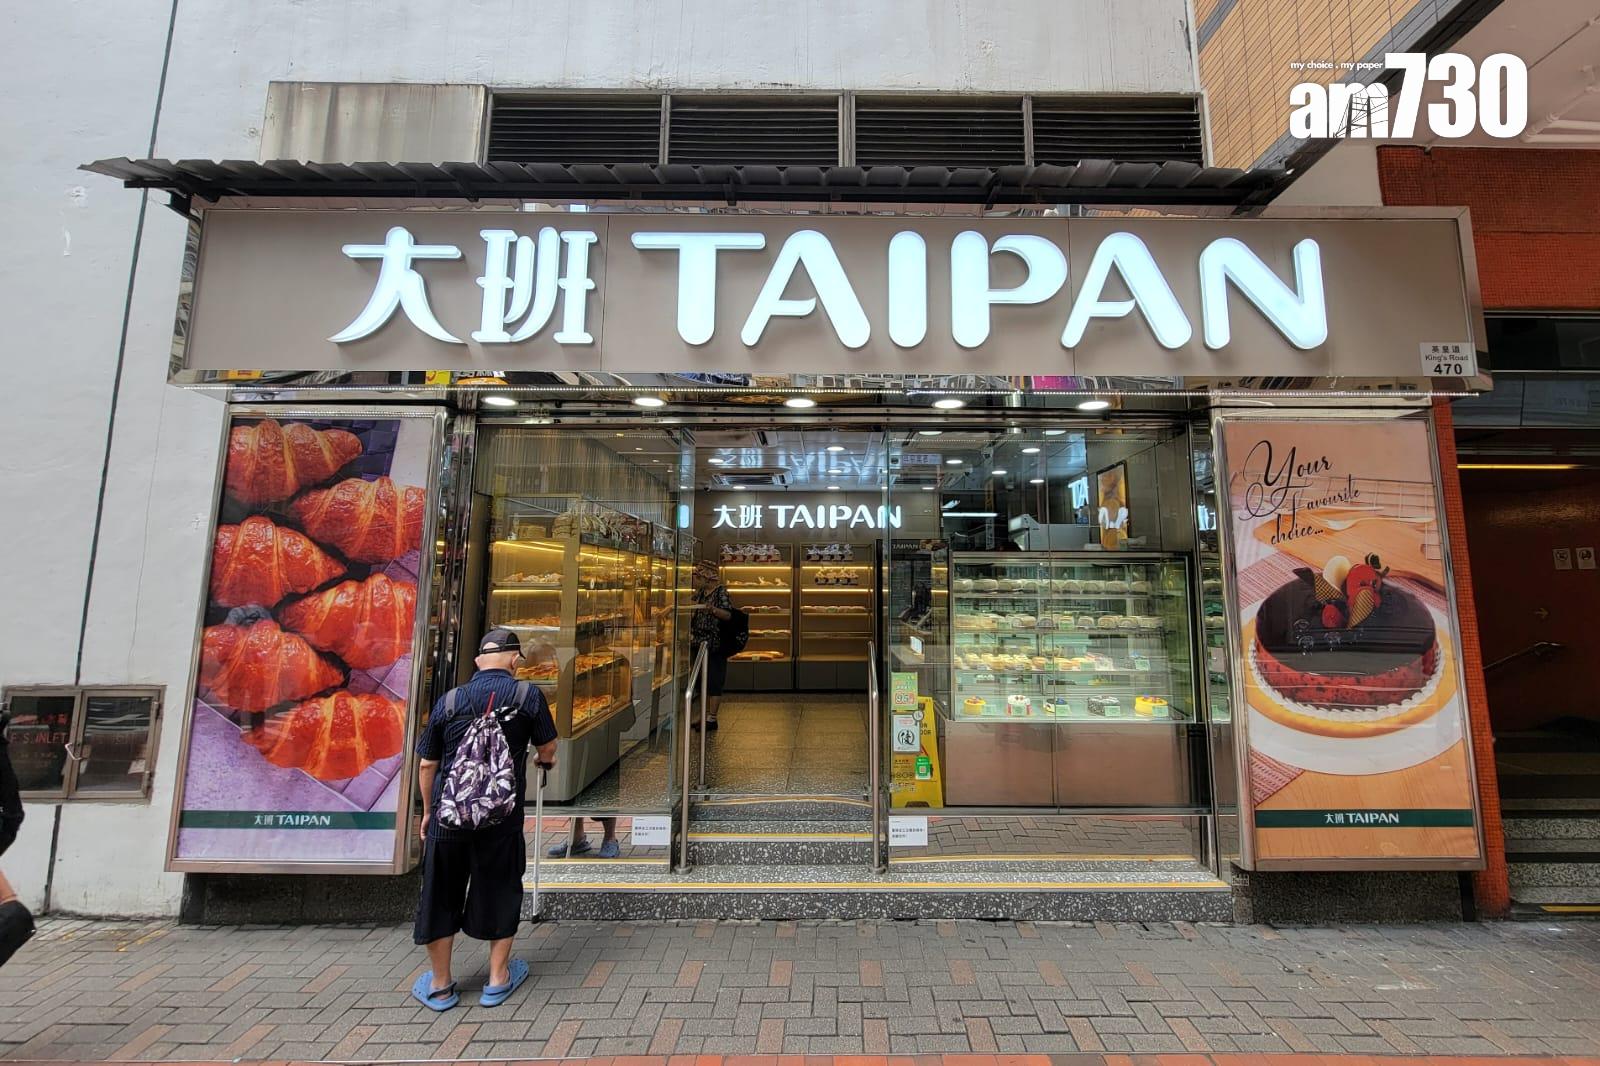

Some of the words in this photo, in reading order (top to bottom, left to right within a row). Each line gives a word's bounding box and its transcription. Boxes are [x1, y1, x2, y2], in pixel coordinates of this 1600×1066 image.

[330, 226, 598, 344] 大班
[631, 229, 1328, 350] TAIPAN
[1425, 354, 1448, 363] King's
[1433, 363, 1463, 375] 470
[1239, 440, 1333, 521] Your
[711, 504, 763, 529] 大班
[768, 504, 902, 529] TAIPAN
[275, 814, 331, 826] TAIPAN
[1324, 813, 1345, 824] 大班
[1345, 812, 1400, 824] TAIPAN
